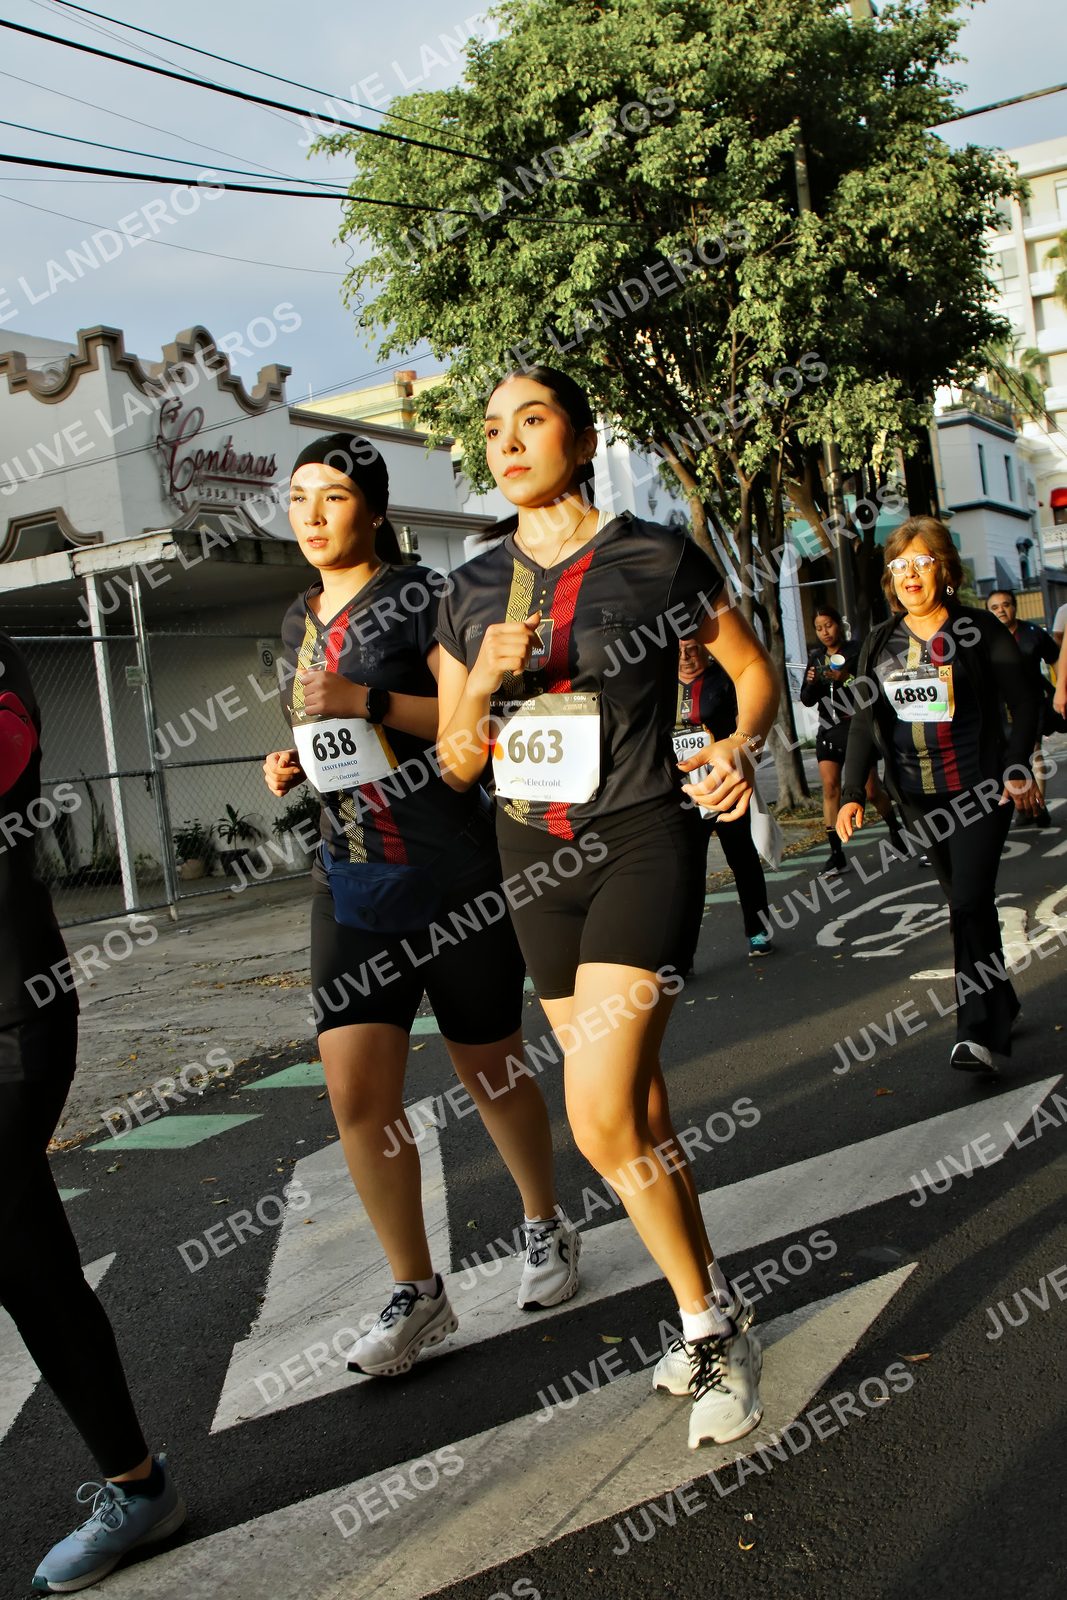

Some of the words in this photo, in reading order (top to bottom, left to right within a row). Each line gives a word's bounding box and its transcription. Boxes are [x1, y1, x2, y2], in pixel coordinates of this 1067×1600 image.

[157, 397, 278, 493] Contreras
[894, 686, 938, 704] 4889
[312, 728, 357, 761] 638
[507, 729, 564, 764] 663
[674, 737, 704, 750] 3098
[338, 759, 358, 769] FRANCO
